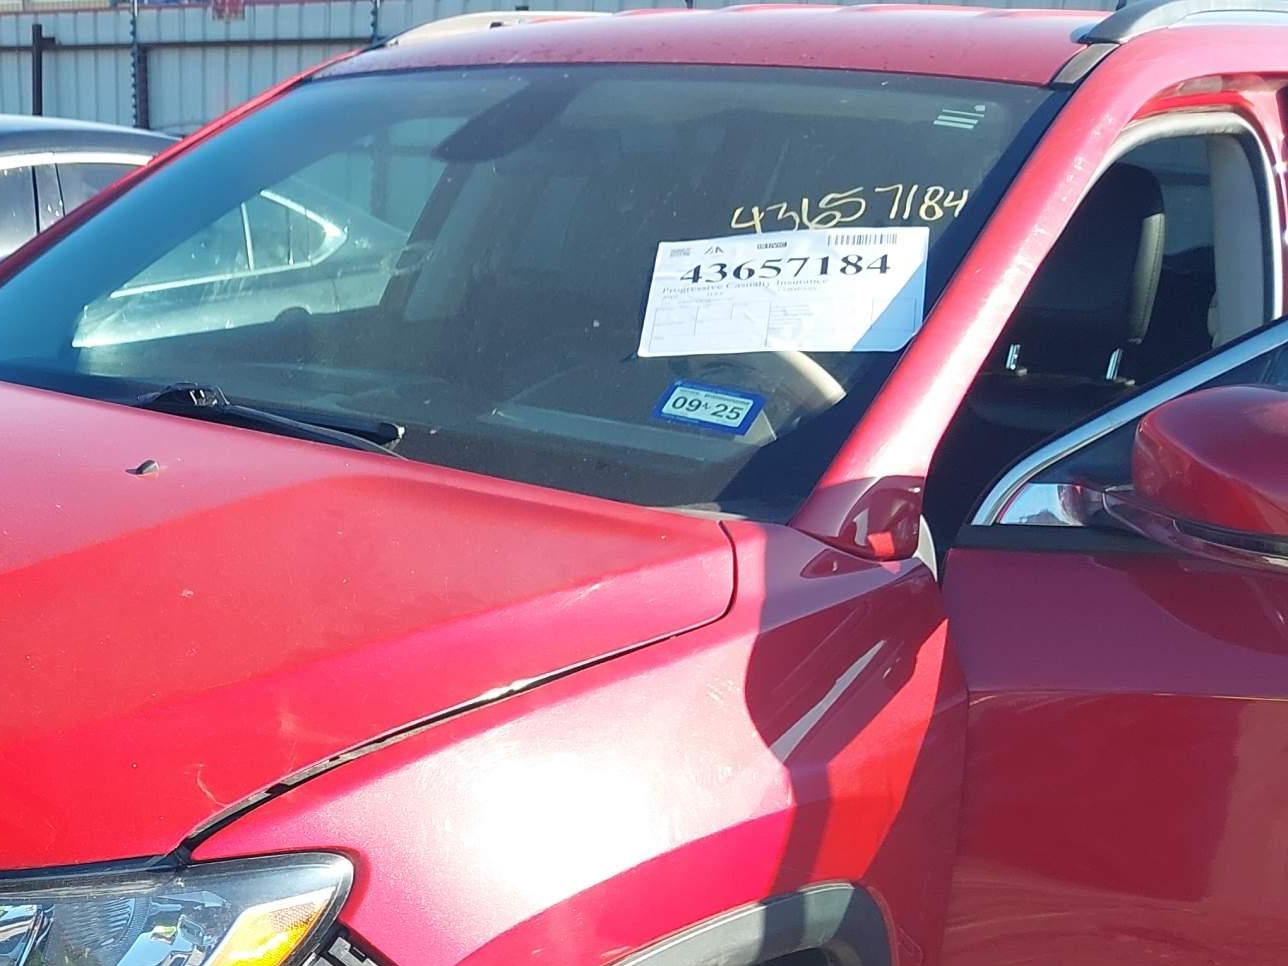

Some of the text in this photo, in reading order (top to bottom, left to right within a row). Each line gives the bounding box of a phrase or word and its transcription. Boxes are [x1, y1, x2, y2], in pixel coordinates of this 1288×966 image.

[679, 253, 892, 284] 43657184
[671, 395, 703, 413] 09
[710, 402, 745, 421] 25
